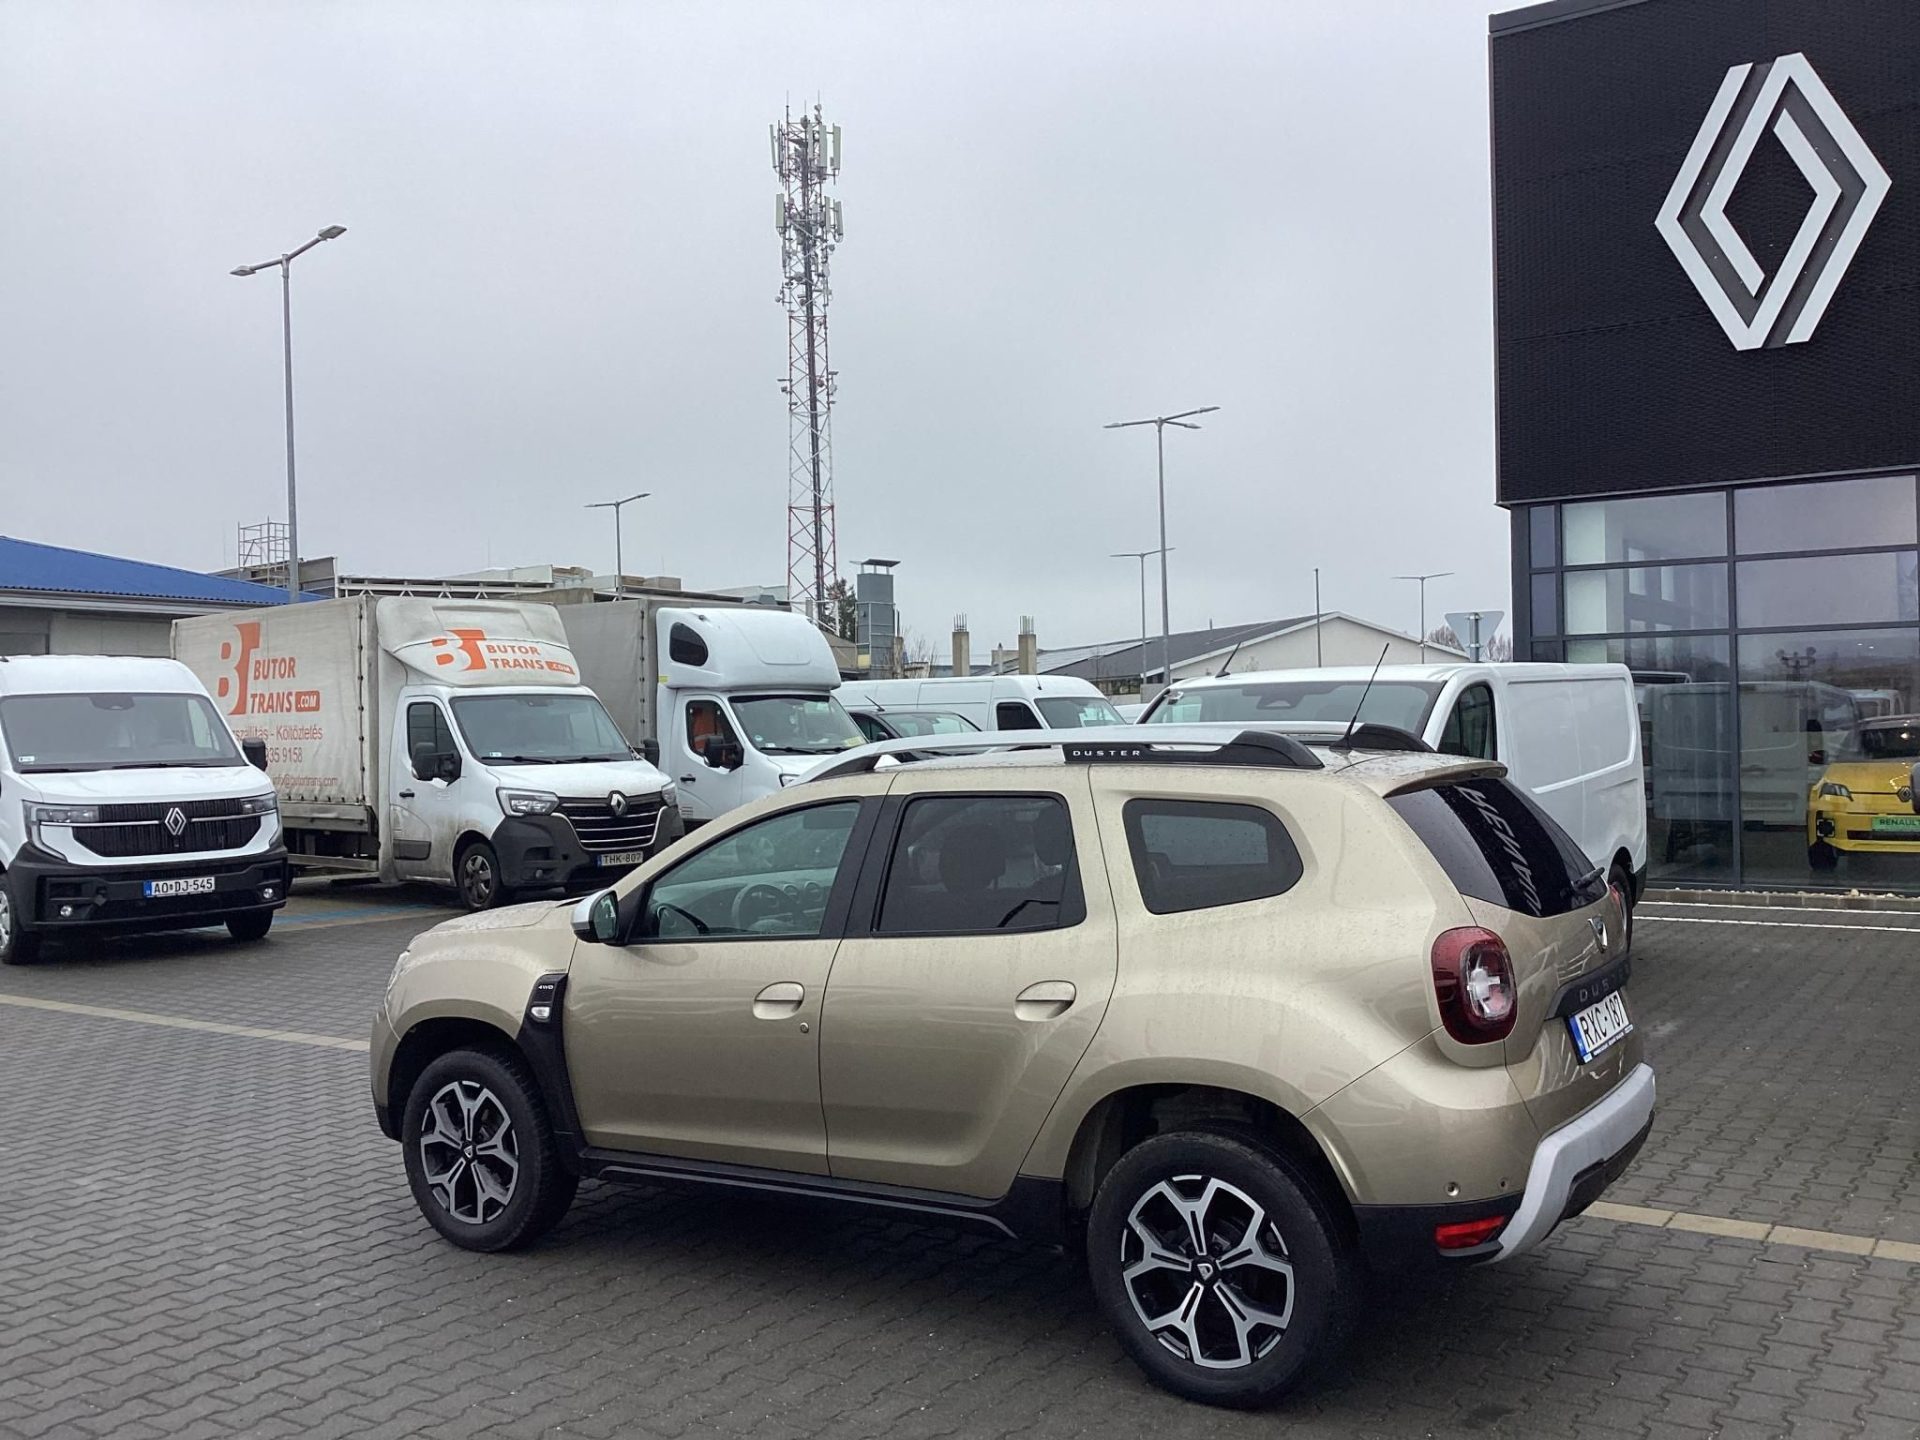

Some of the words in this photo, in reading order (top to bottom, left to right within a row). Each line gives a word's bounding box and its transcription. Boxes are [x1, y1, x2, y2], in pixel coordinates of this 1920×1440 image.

[485, 644, 541, 656] BUTOR
[253, 656, 297, 681] BUTOR
[489, 658, 544, 670] TRANS
[250, 690, 294, 714] TRANS
[282, 746, 303, 763] 9158
[1072, 749, 1141, 757] DUSTER
[1879, 818, 1920, 826] RENAUL
[603, 853, 642, 864] THK-807
[154, 882, 169, 894] AO
[174, 878, 213, 892] DJ-545
[1579, 993, 1625, 1049] RXC-187
